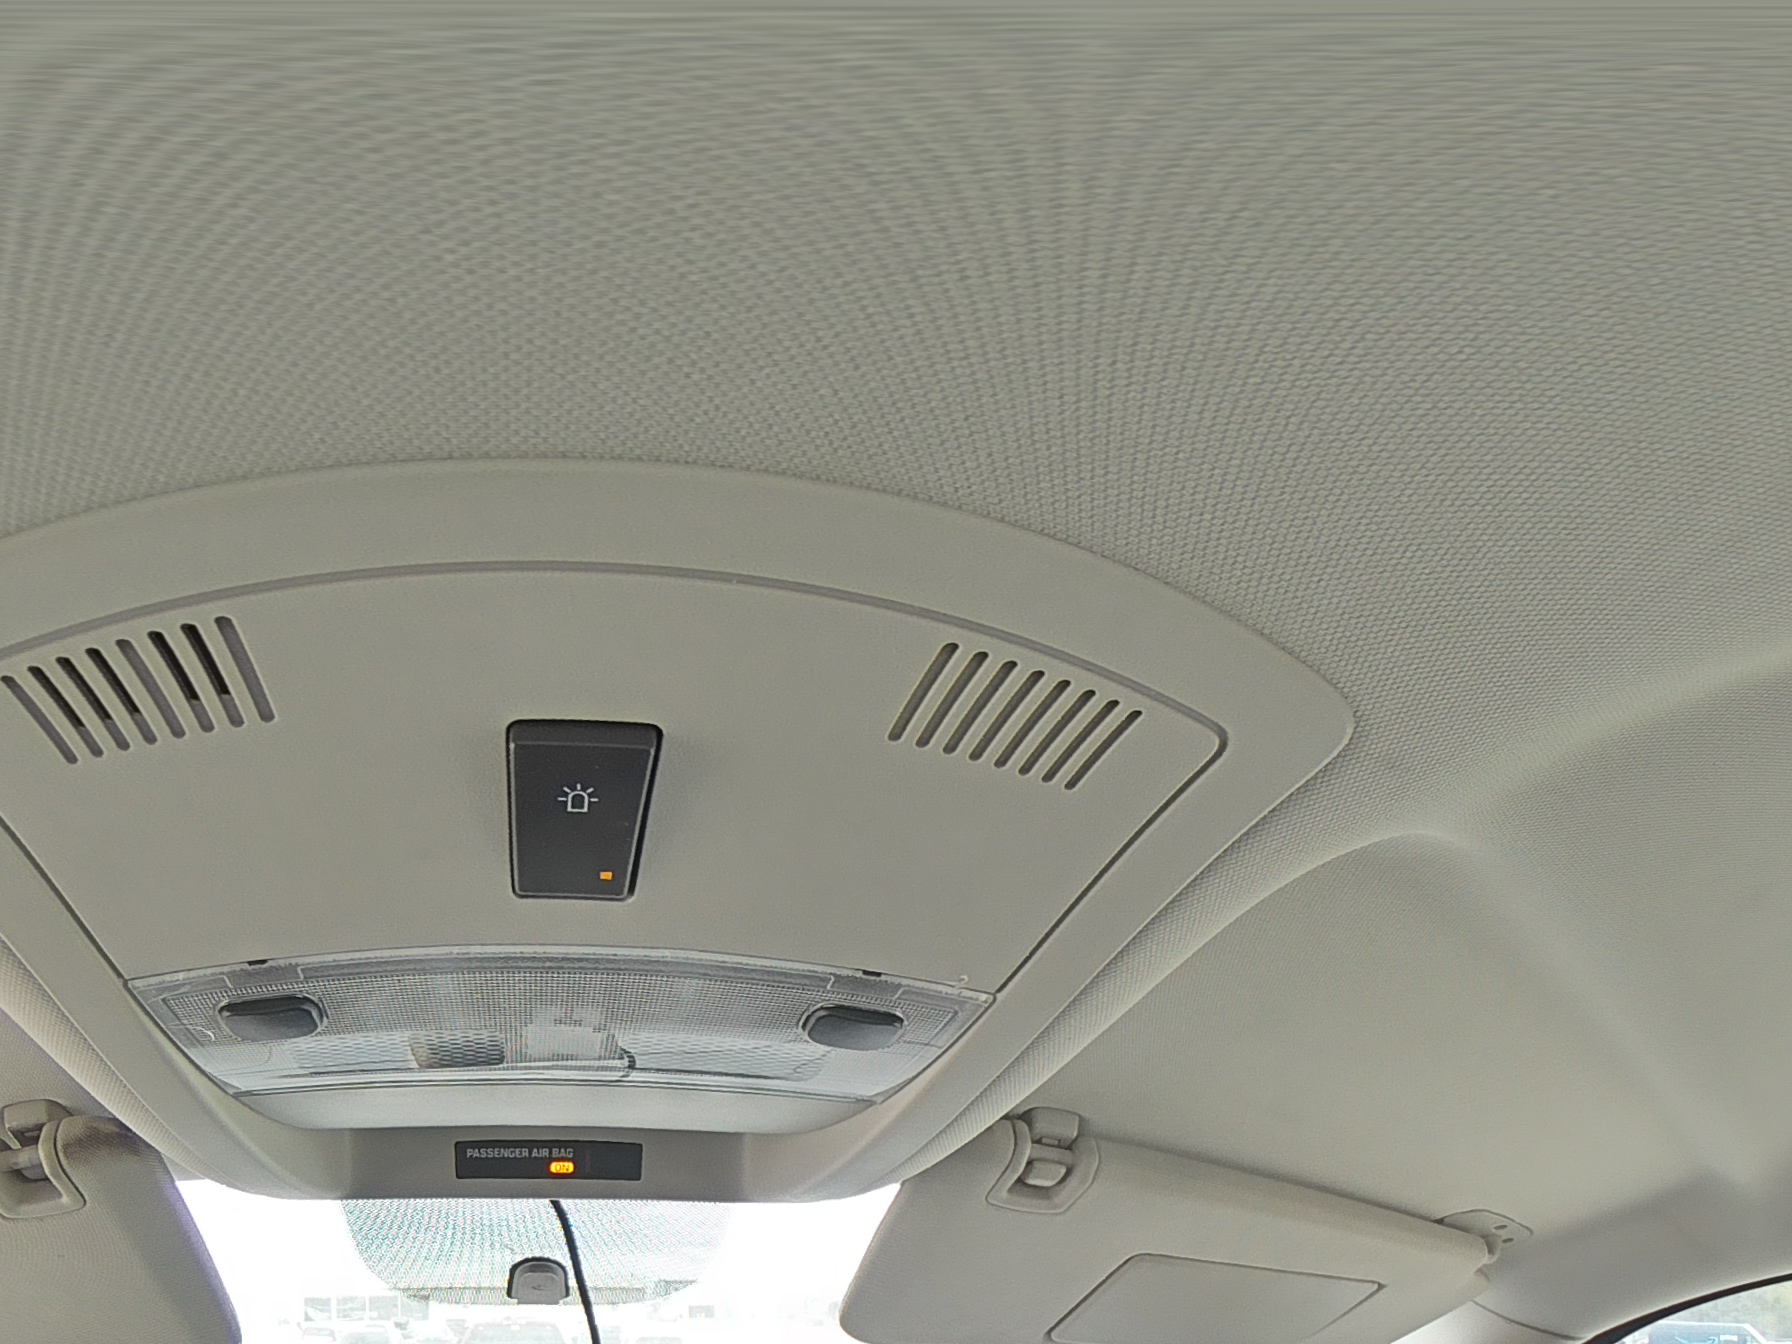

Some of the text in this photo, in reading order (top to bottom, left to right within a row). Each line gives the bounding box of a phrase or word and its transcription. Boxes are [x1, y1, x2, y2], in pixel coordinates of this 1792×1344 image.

[466, 1147, 574, 1158] PASSENGER AIR BAG
[553, 1162, 571, 1173] ON
